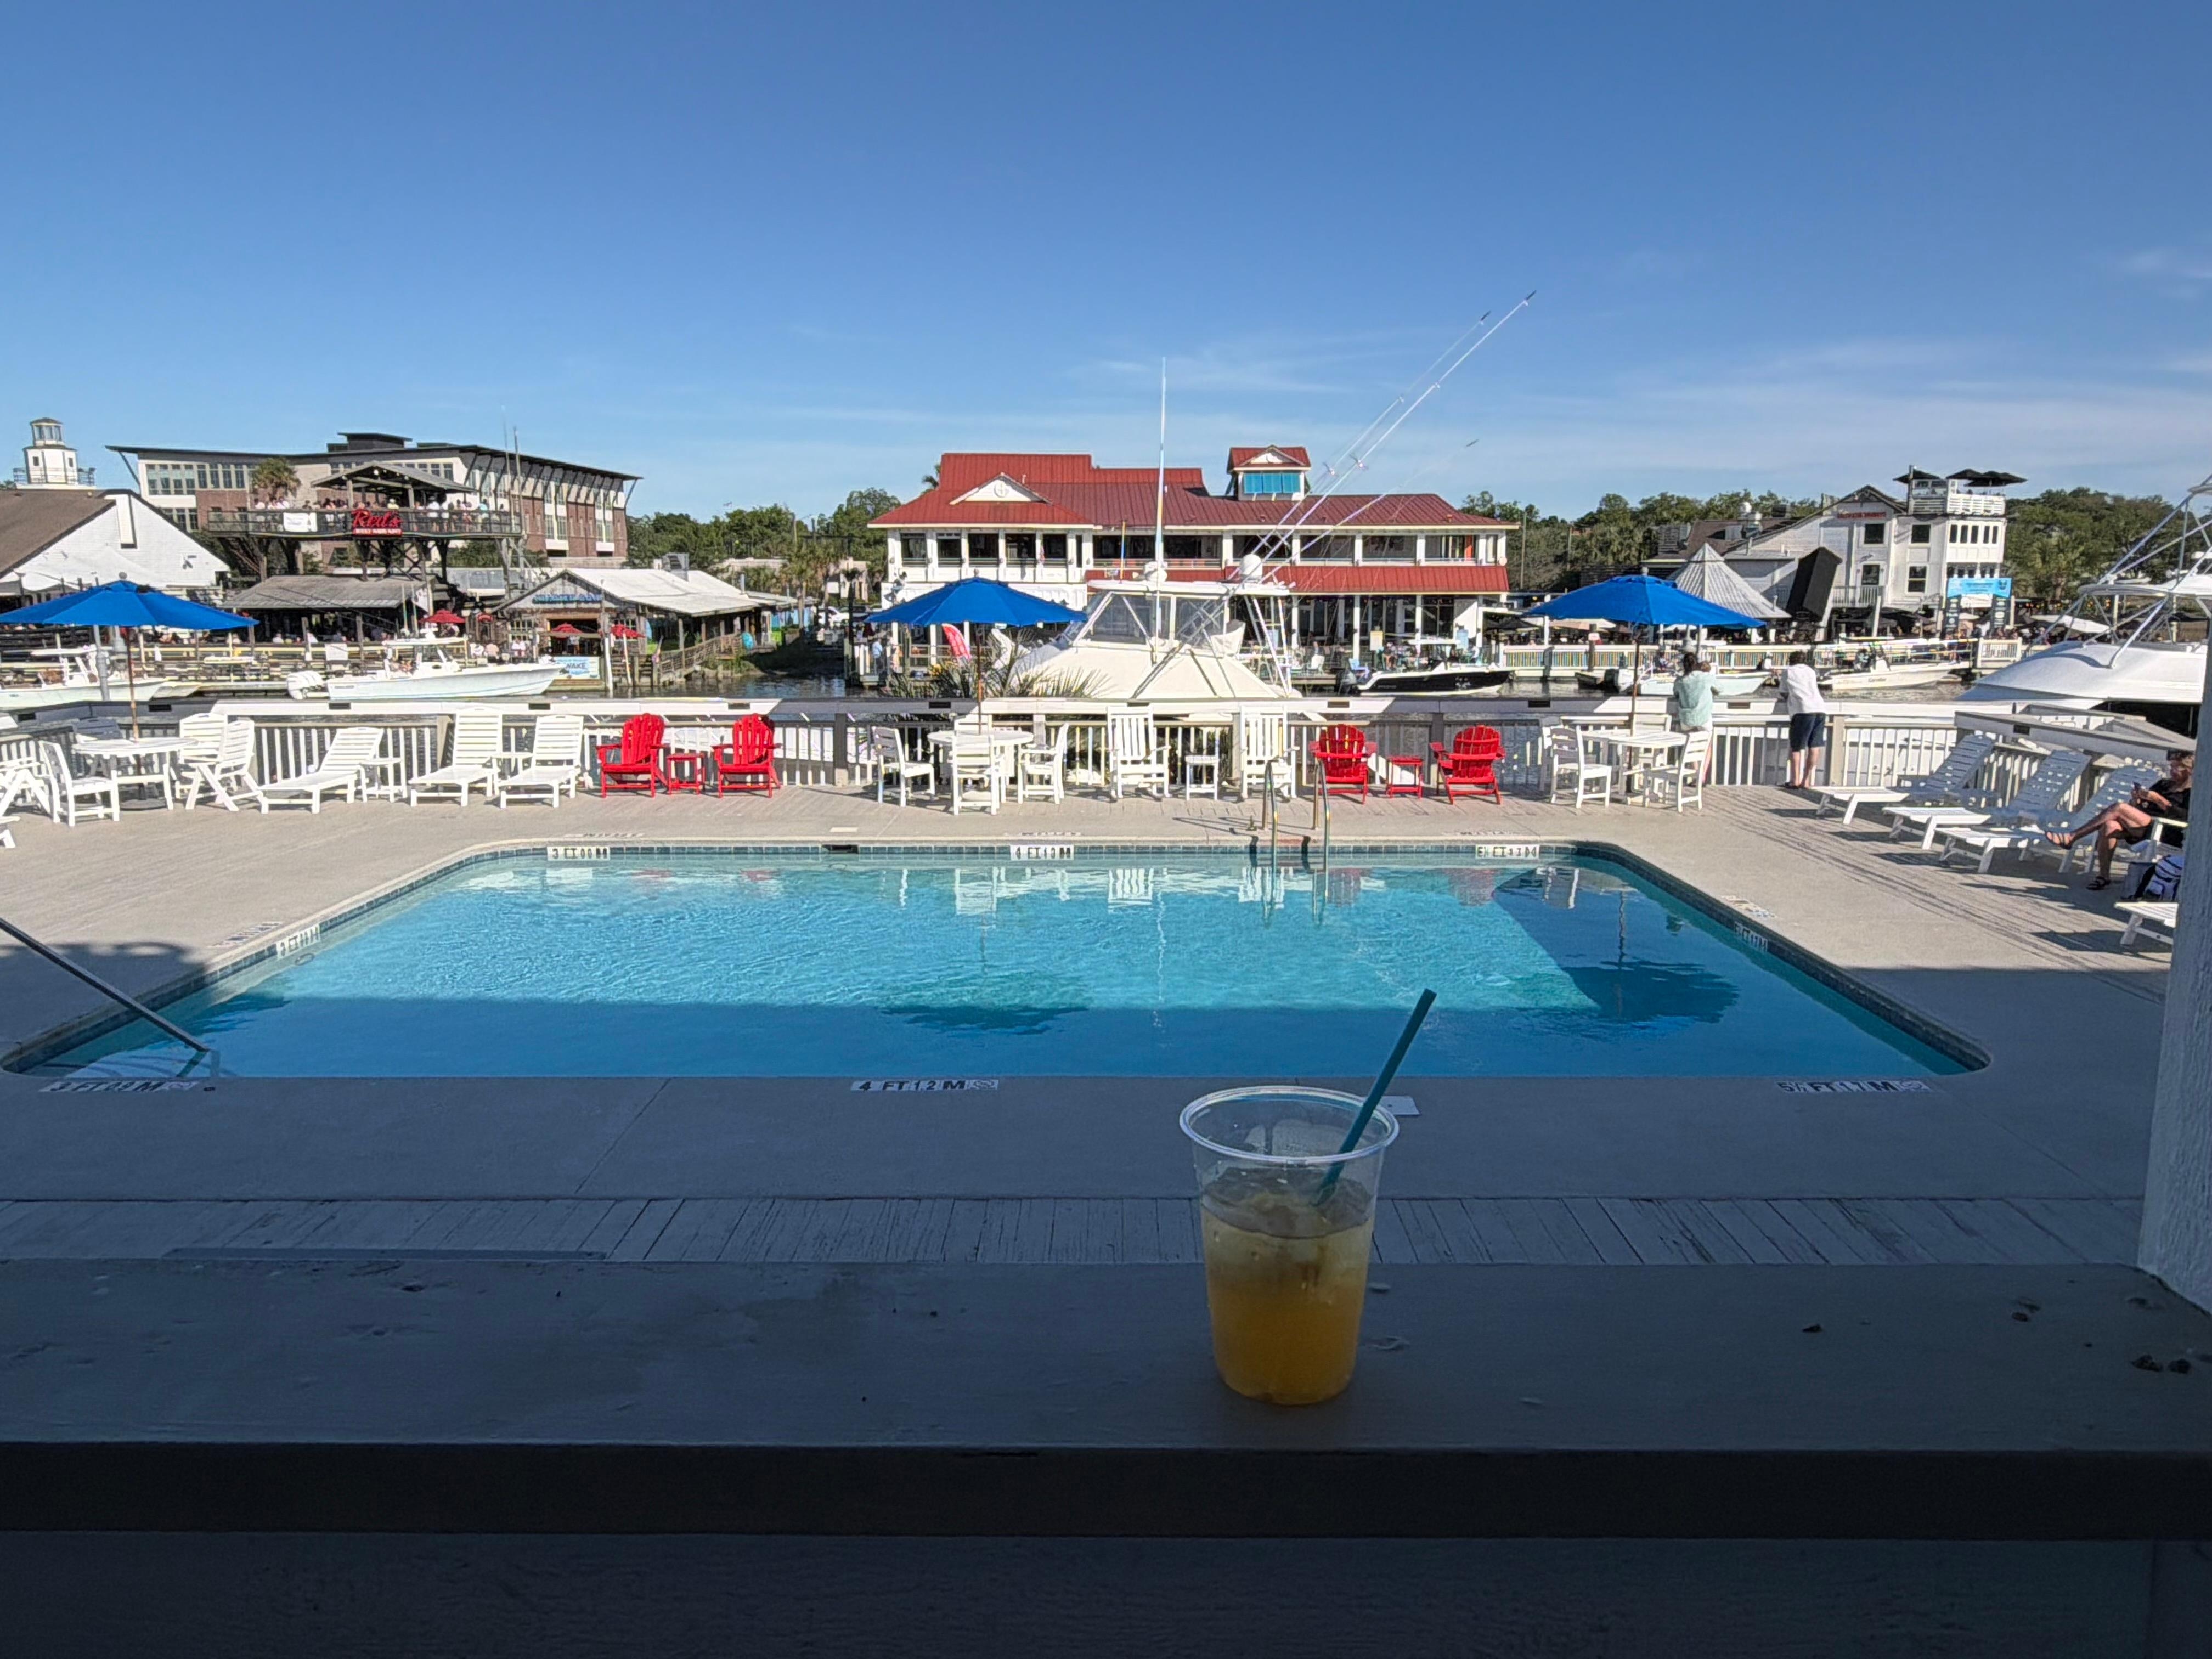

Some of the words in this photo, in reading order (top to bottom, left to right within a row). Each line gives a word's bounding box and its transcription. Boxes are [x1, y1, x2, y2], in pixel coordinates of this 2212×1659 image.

[859, 1081, 872, 1091] 4
[882, 1081, 910, 1091] FT
[943, 1080, 966, 1090] M
